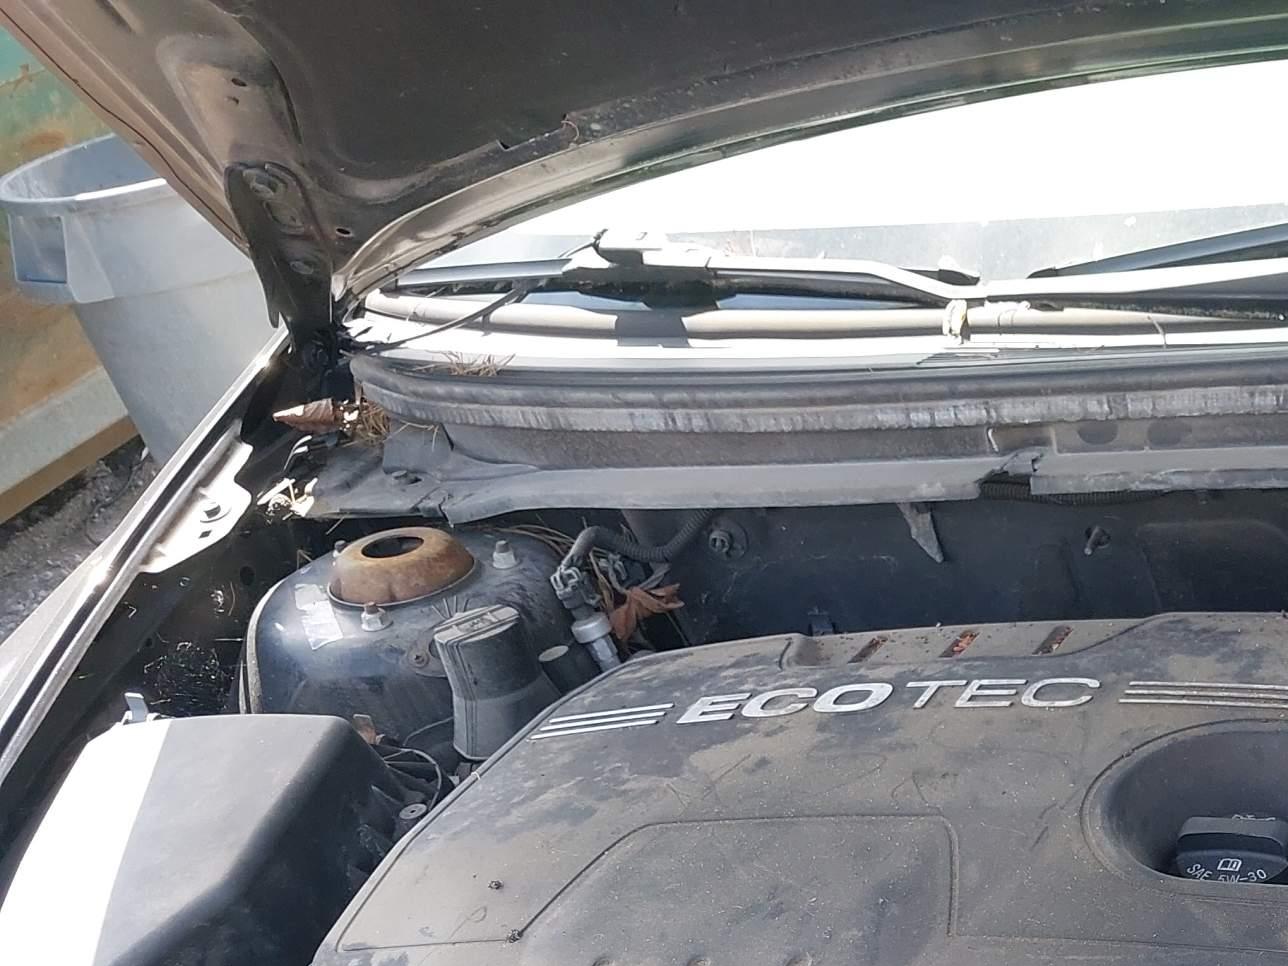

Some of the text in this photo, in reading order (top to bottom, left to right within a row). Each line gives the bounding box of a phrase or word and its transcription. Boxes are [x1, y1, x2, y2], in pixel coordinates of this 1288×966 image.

[676, 677, 1101, 725] ECOTEC
[1187, 864, 1268, 883] SAE 5W-30
